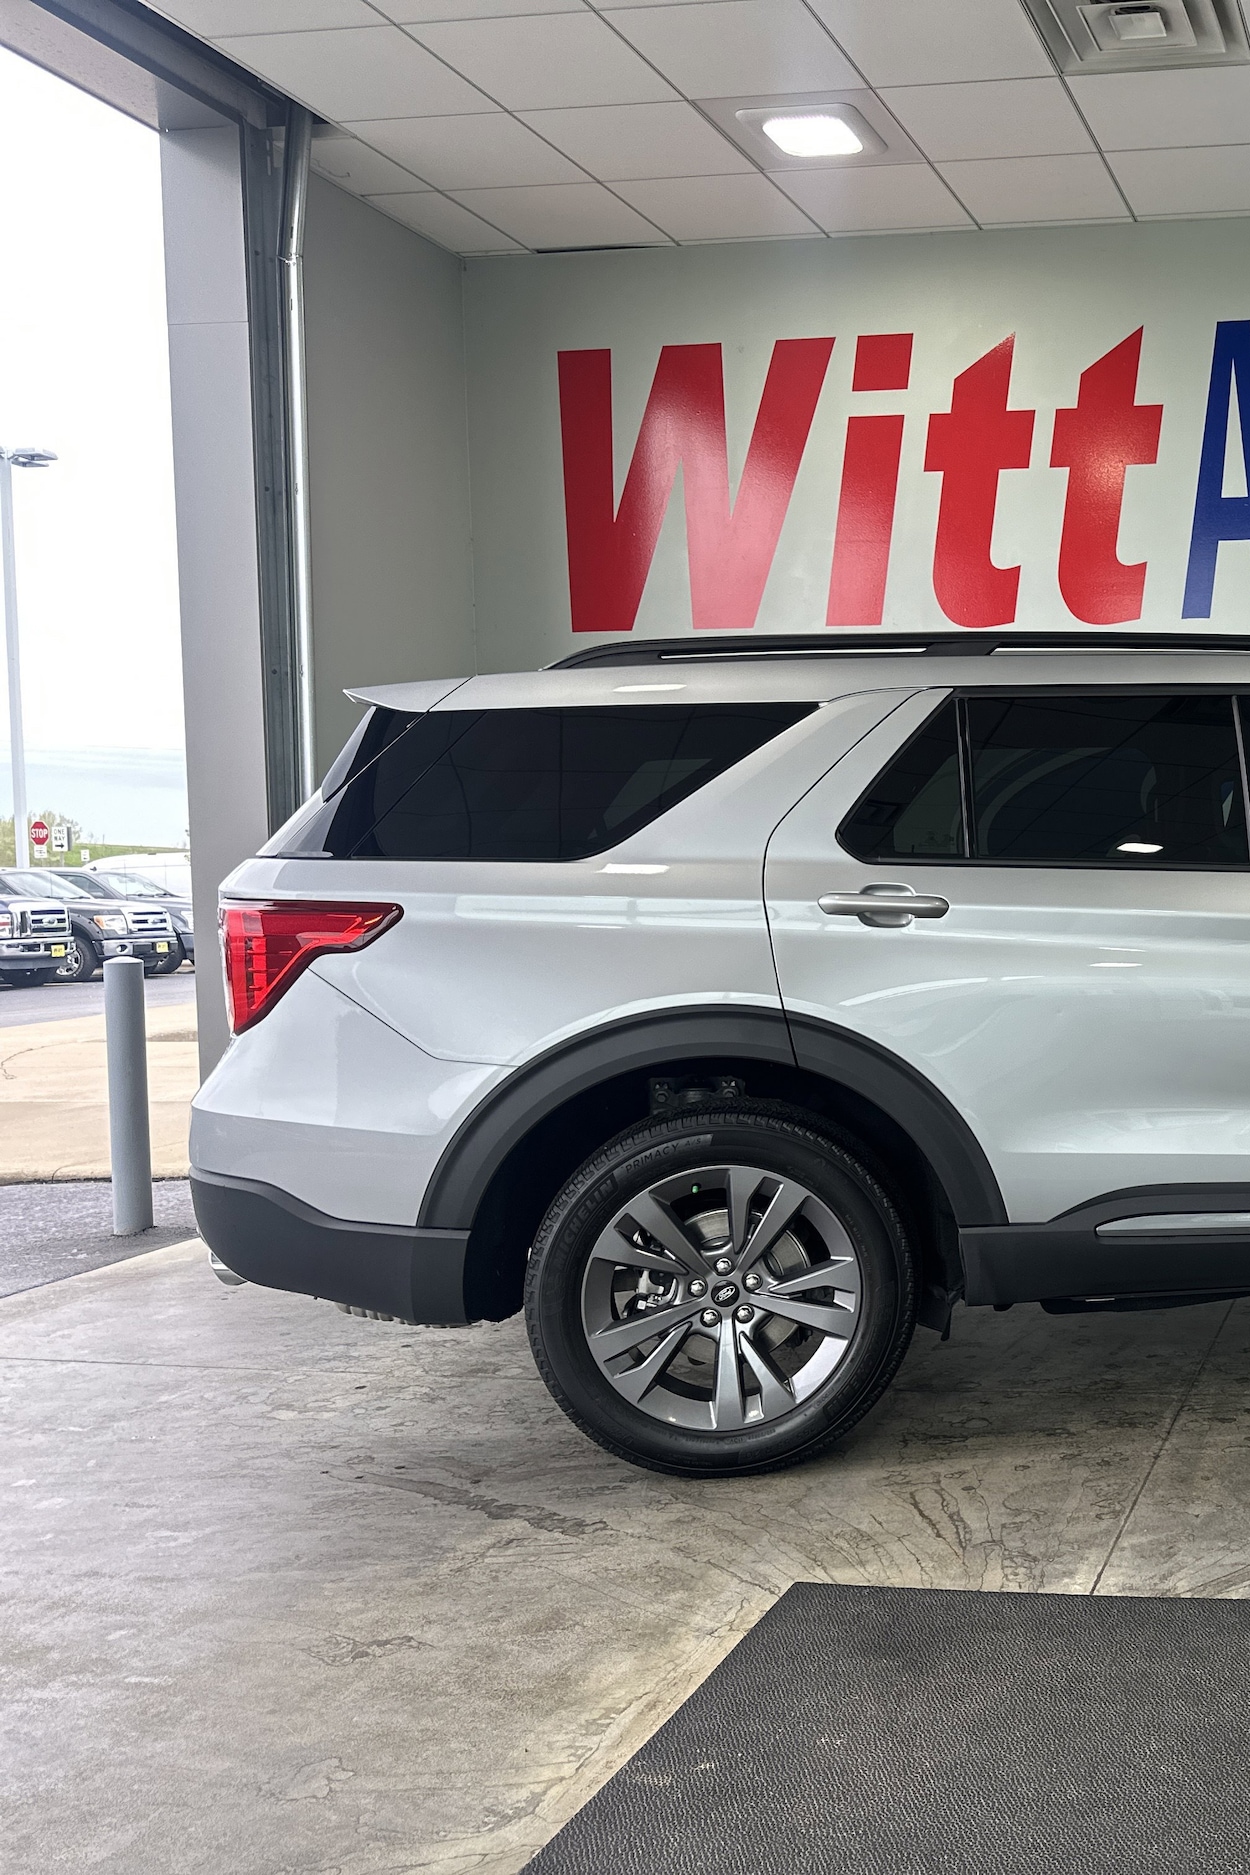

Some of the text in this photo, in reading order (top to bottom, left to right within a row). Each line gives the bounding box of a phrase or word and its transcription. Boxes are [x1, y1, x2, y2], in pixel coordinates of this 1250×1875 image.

[31, 828, 48, 839] STOP
[625, 1138, 702, 1174] PRIMACY A/S
[552, 1177, 616, 1270] MICHELIN
